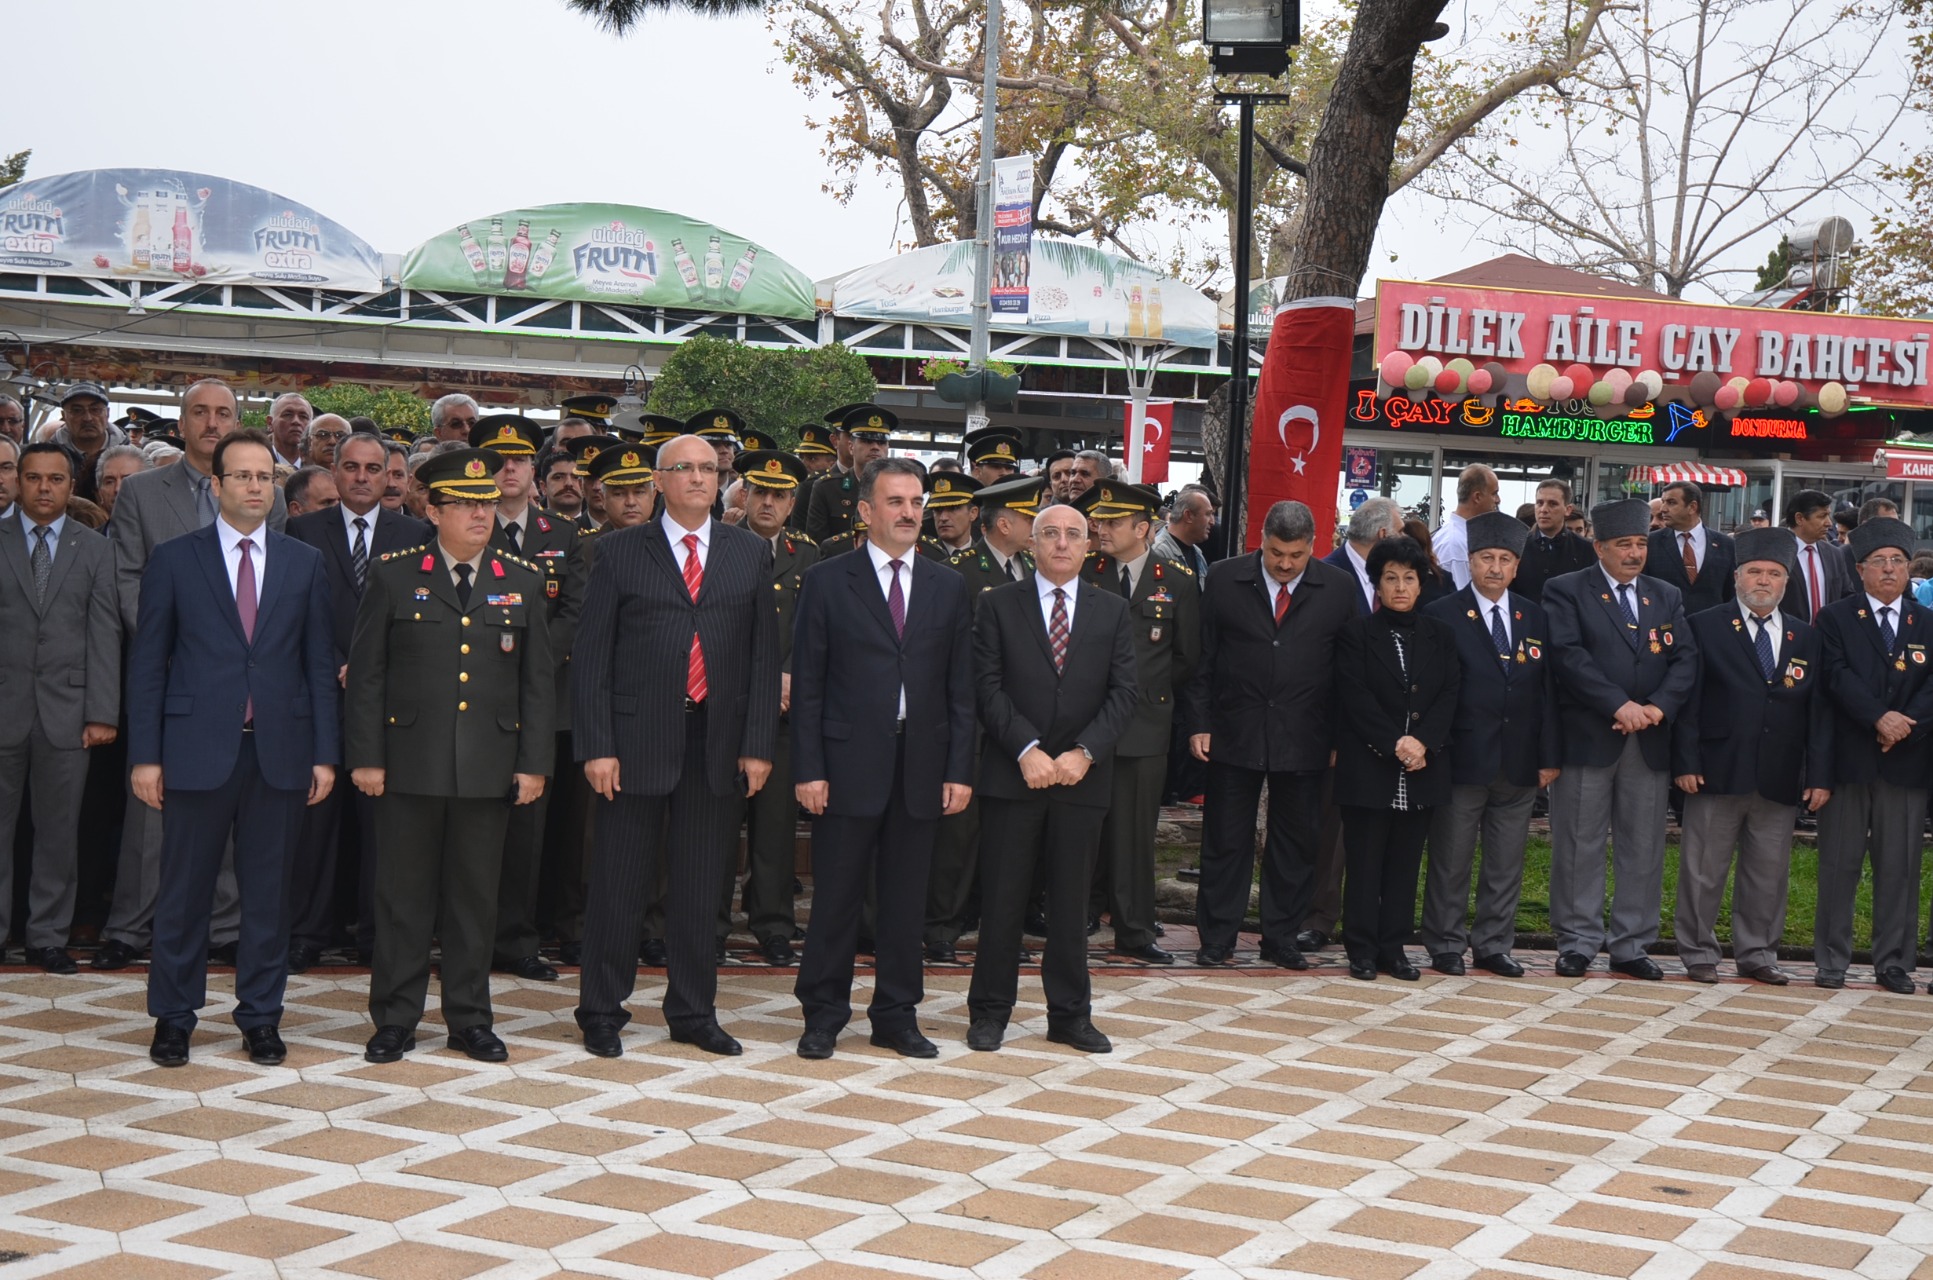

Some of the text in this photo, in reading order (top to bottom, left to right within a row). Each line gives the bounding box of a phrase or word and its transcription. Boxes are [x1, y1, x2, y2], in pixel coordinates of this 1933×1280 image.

[4, 234, 54, 254] extra
[592, 226, 645, 248] uludağ
[265, 250, 312, 270] extra
[1398, 296, 1930, 391] DİLEK AİLE ÇAY BAHÇESİ
[1384, 396, 1457, 428] ÇAY
[1502, 415, 1654, 444] HAMBURGER
[1732, 418, 1807, 440] DONDURMA
